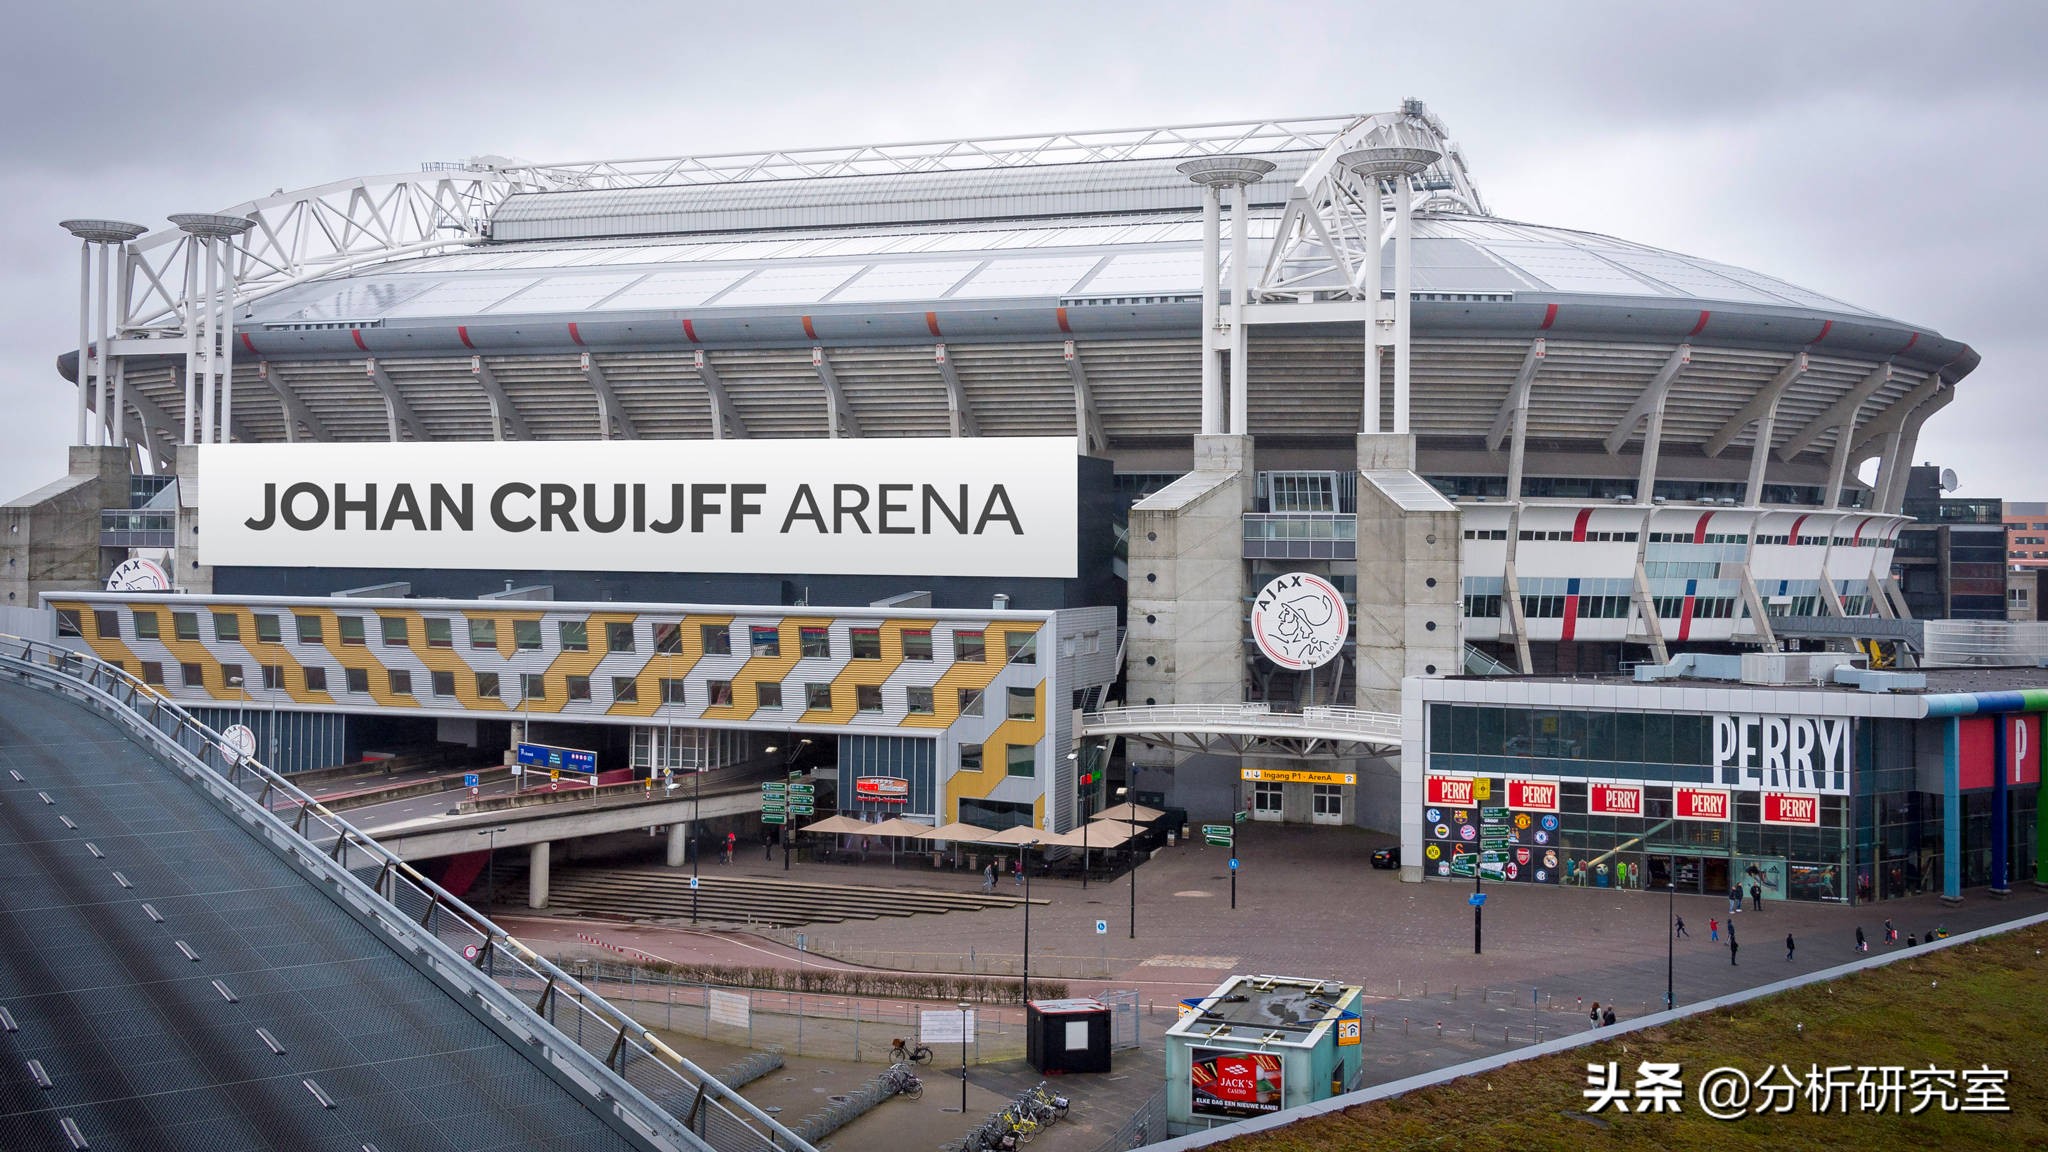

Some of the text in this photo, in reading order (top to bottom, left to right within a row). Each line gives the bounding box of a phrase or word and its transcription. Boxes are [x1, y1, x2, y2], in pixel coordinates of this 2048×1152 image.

[244, 481, 1025, 535] JOHAN CRUIJFF ARENA
[110, 560, 141, 590] AJAX
[1258, 575, 1302, 612] AJAX
[1302, 634, 1341, 665] ATERDAM
[1713, 714, 1845, 790] PERRY
[2015, 719, 2027, 782] P
[1264, 770, 1290, 780] Ingang
[1441, 781, 1472, 800] PERRY
[1522, 785, 1553, 804] PERRY
[1606, 790, 1638, 809] PERRY
[1691, 794, 1725, 813] PERRY
[1779, 798, 1814, 818] PERRY
[1220, 1077, 1254, 1089] JACK'S
[1236, 1101, 1260, 1109] NIEUWE
[1260, 1103, 1279, 1111] KANS!
